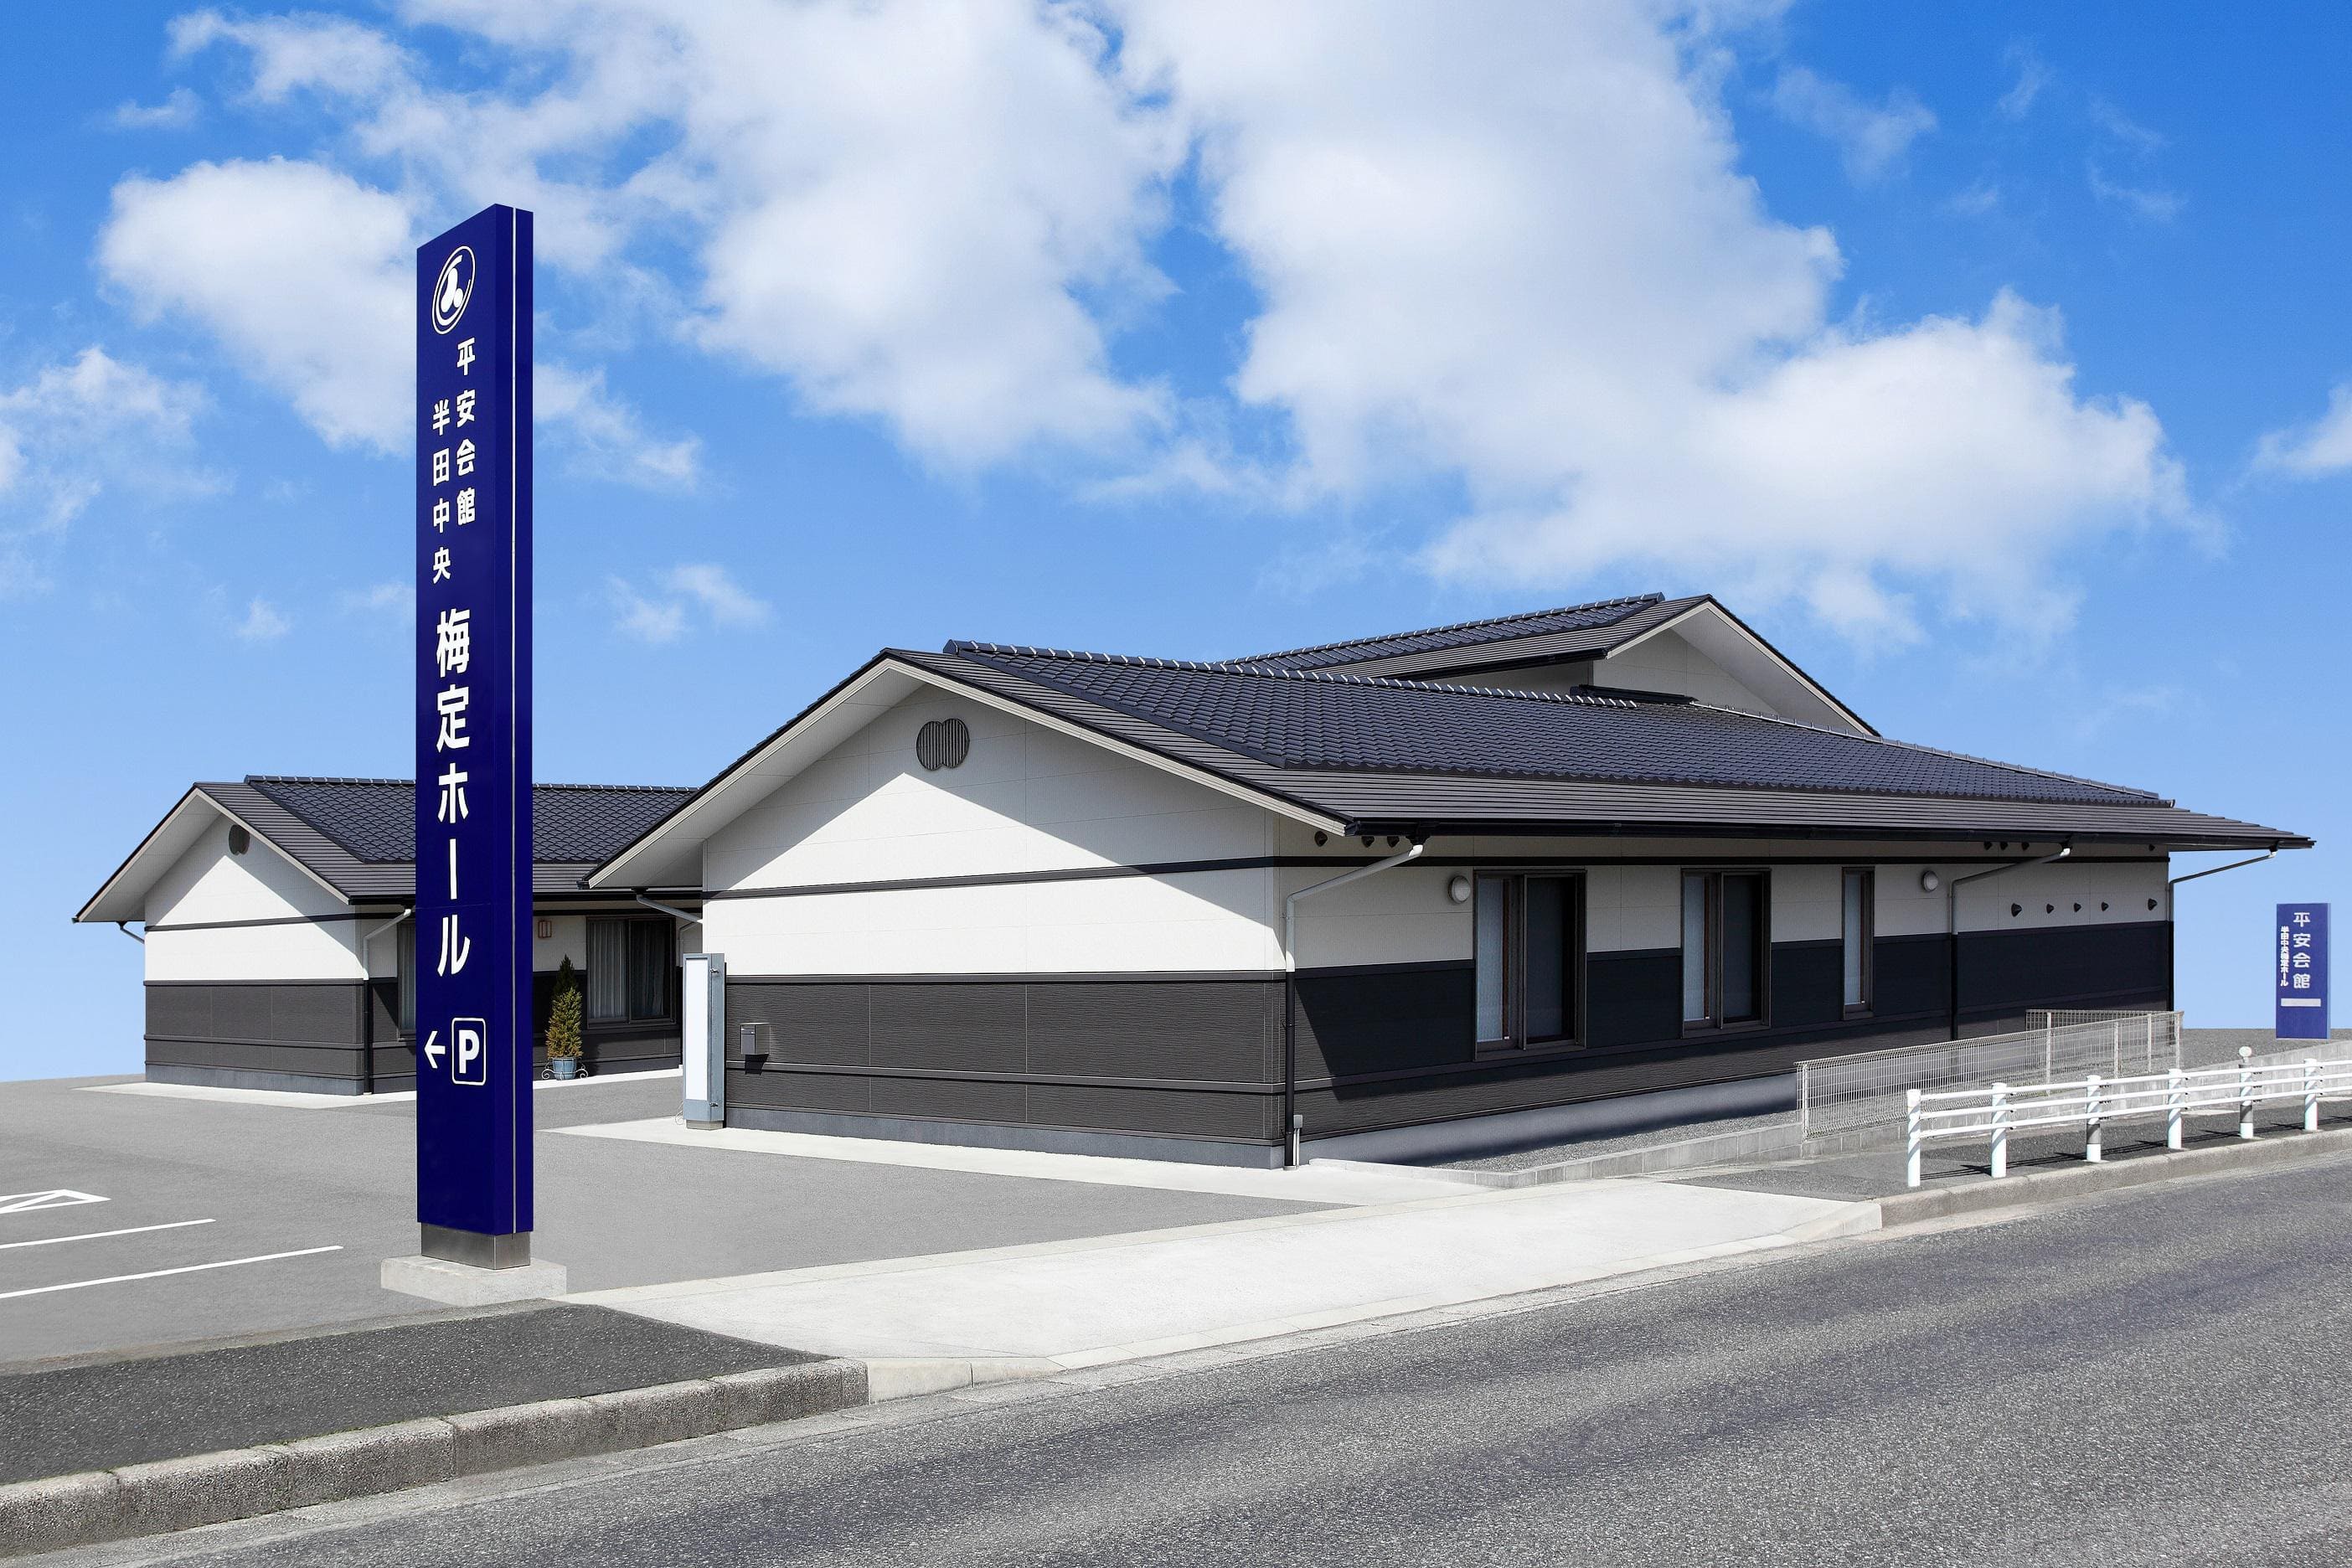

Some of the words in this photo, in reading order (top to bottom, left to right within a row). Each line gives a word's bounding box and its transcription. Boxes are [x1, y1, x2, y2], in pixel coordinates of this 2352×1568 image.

[432, 399, 451, 584] 半田中央
[456, 337, 476, 526] 平安会館
[436, 607, 471, 977] 梅定ホール
[2293, 911, 2311, 988] 平安会館
[459, 1029, 480, 1074] P
